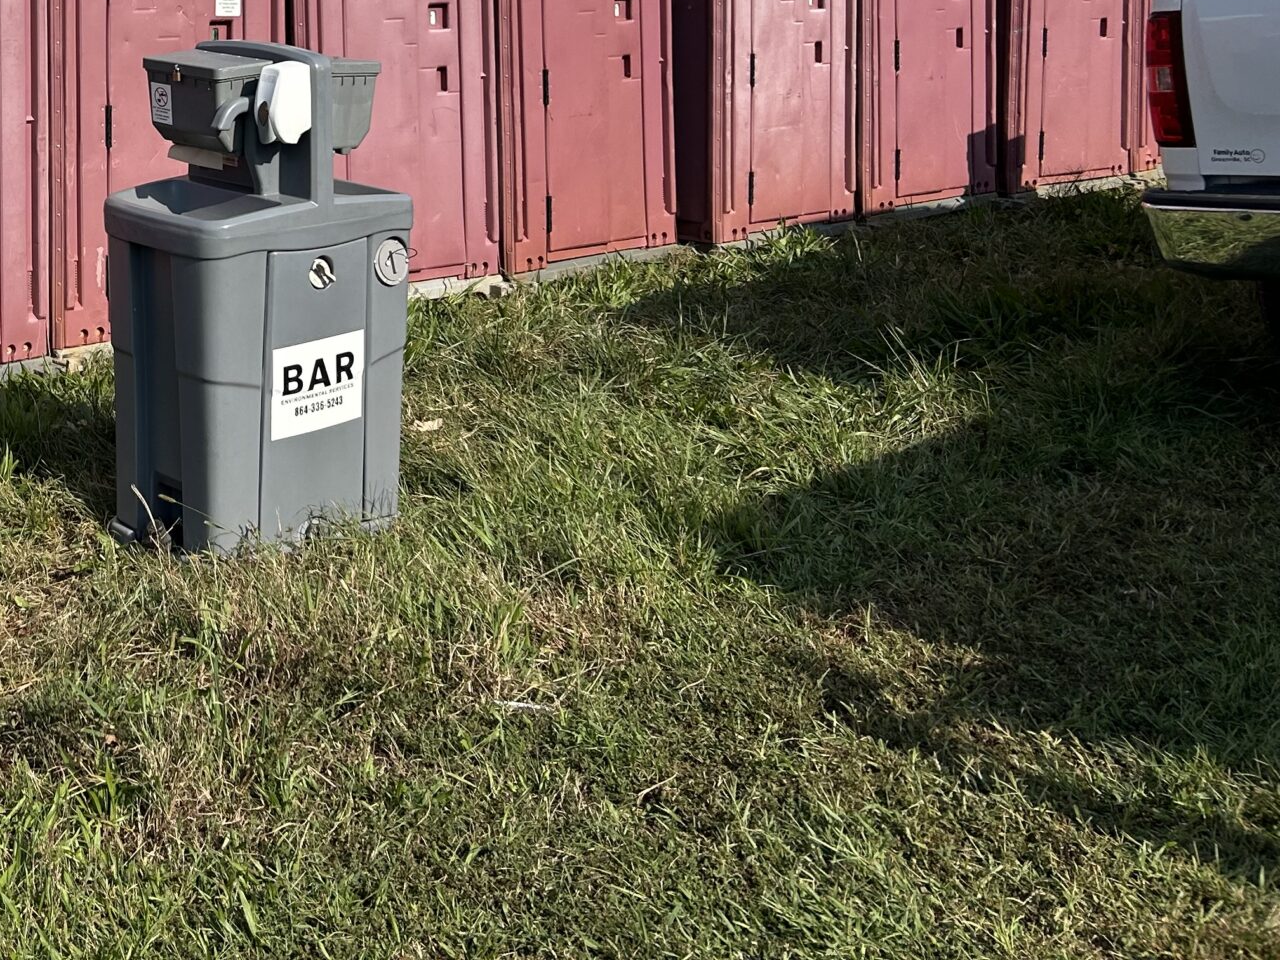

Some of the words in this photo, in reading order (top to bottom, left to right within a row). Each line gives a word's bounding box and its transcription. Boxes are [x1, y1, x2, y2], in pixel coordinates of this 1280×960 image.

[1213, 149, 1233, 157] Family
[282, 351, 354, 396] BAR
[281, 390, 328, 406] ENVIRONMENTAL
[328, 382, 354, 394] SERVICES
